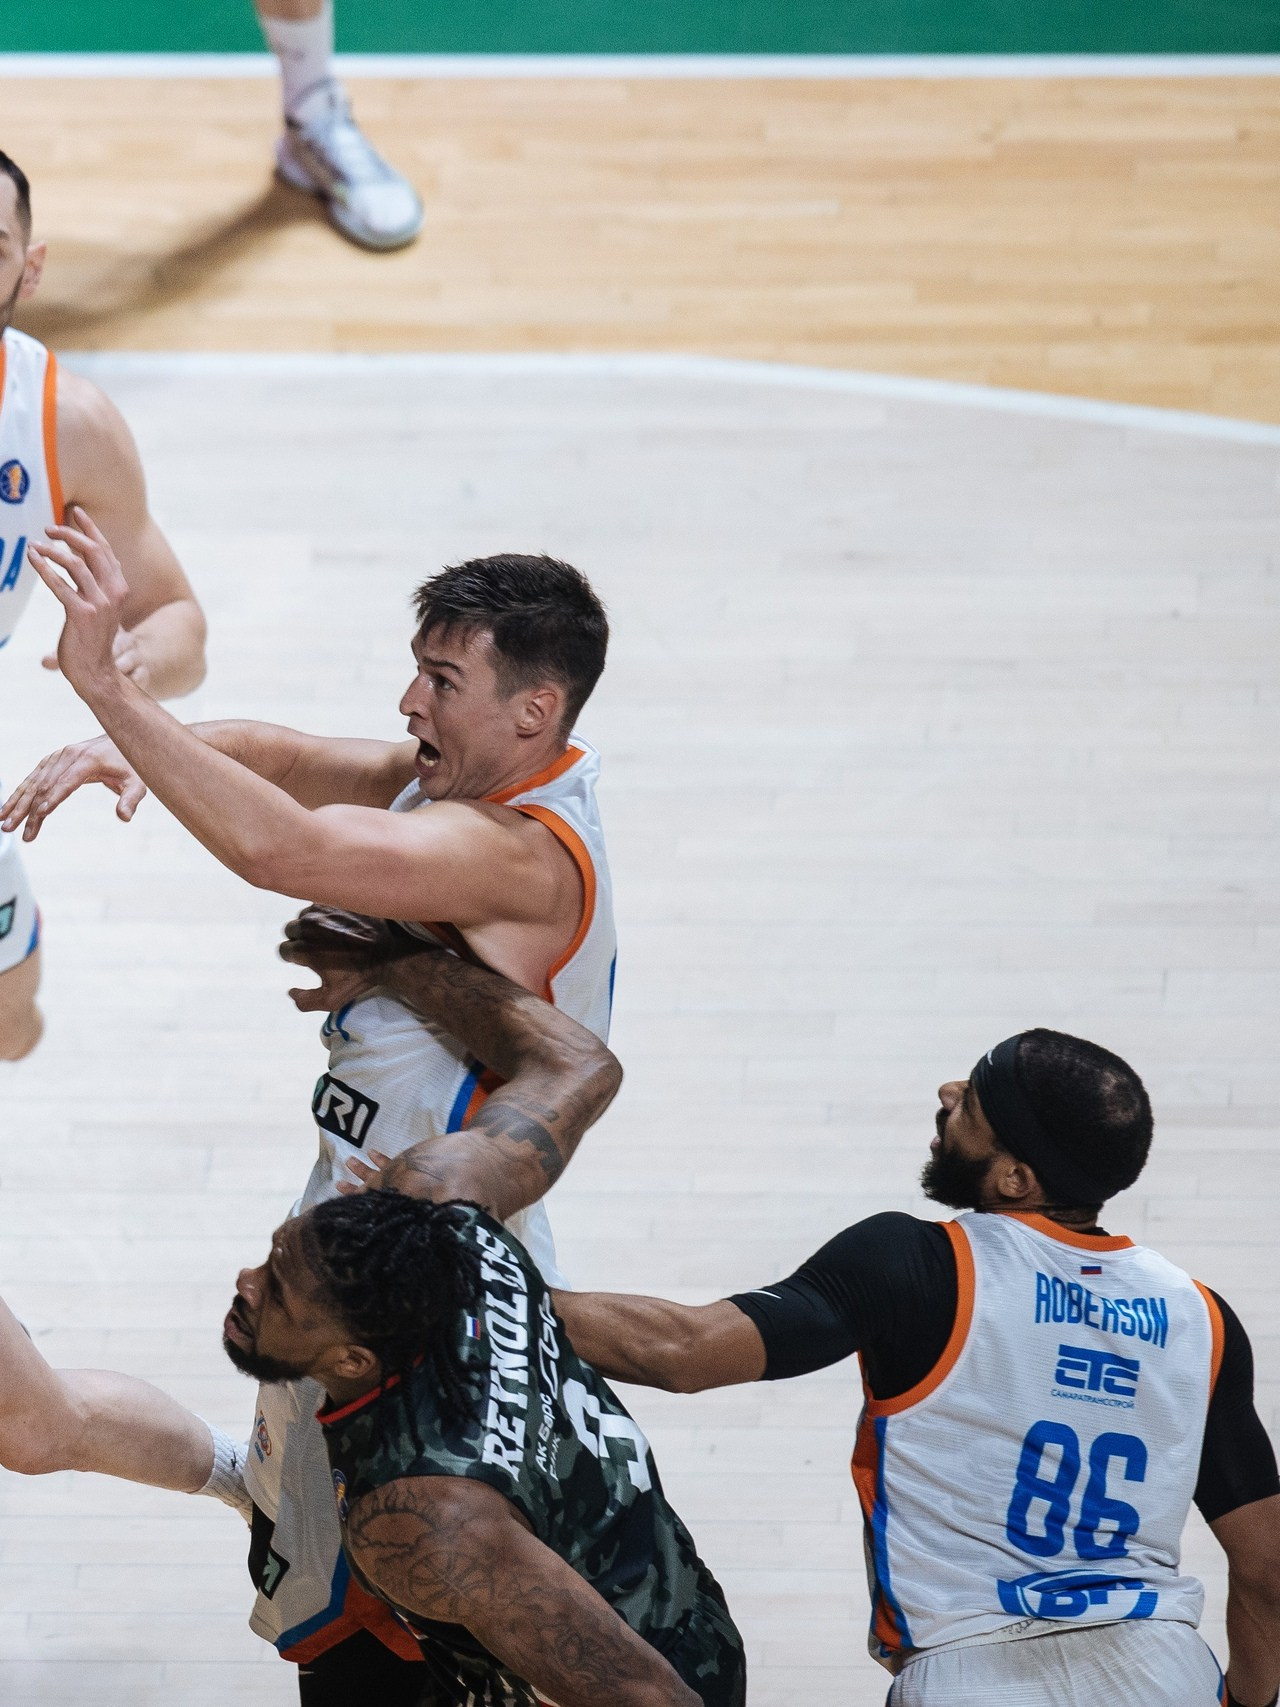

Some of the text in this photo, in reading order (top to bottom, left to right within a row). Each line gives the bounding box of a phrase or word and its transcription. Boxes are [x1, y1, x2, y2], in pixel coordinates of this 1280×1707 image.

[476, 1225, 529, 1482] REYNOLDS
[1035, 1272, 1168, 1349] ROBERSON
[1007, 1419, 1148, 1559] 86
